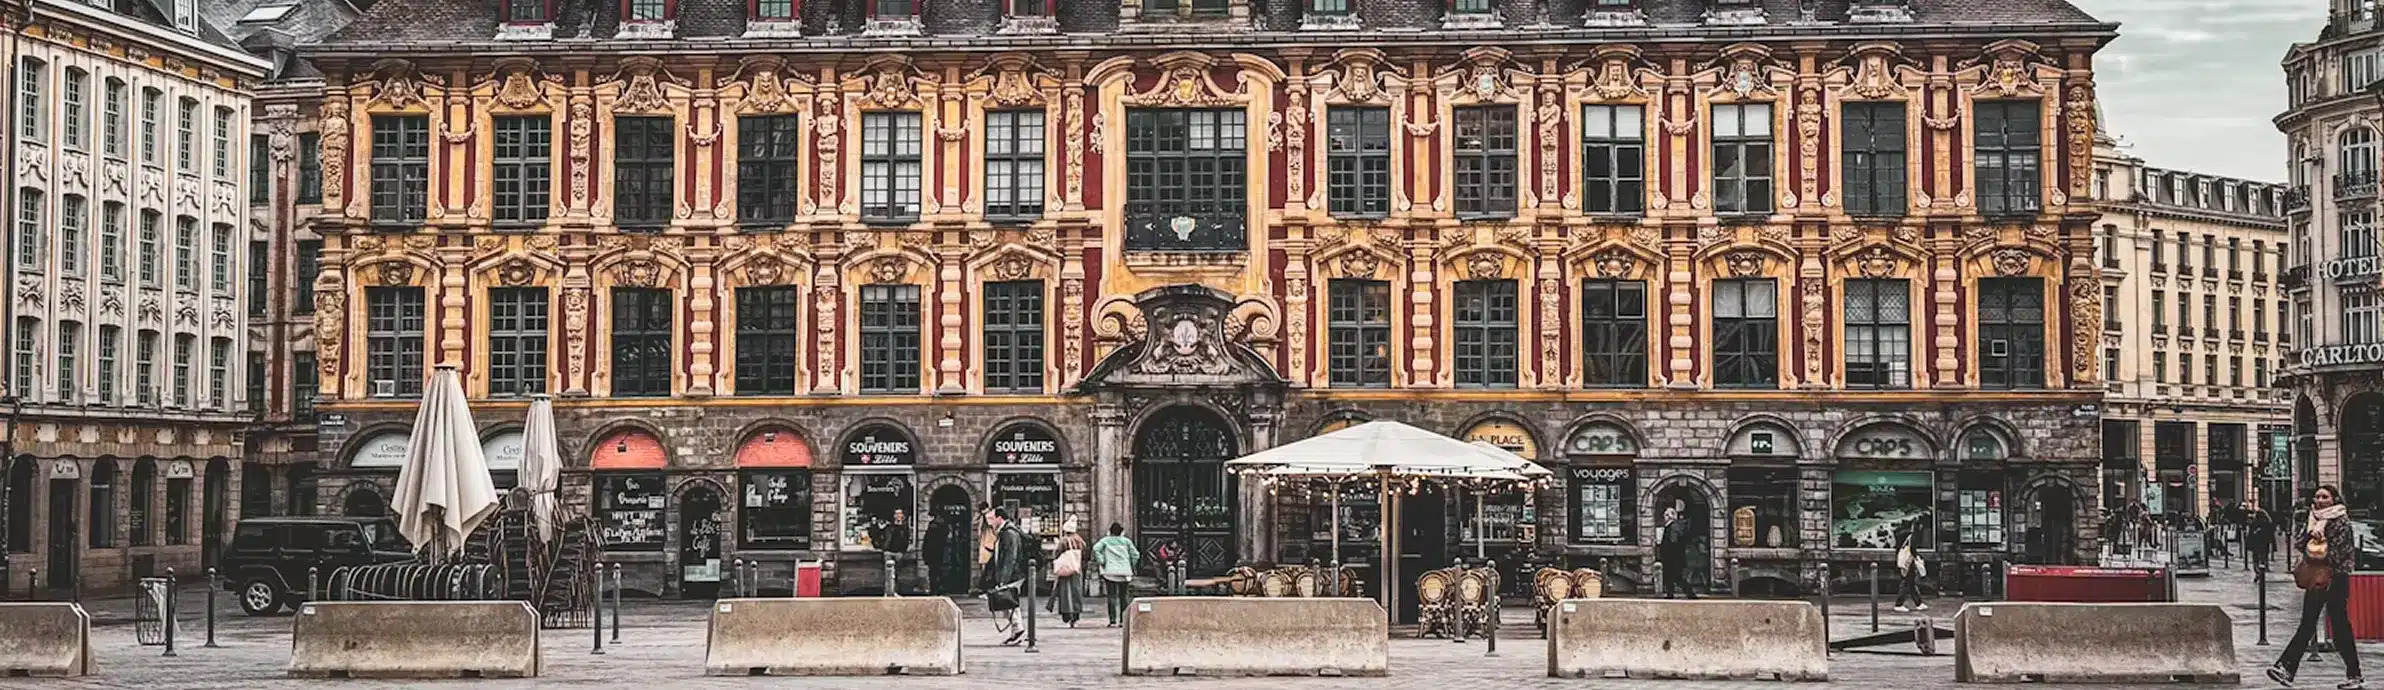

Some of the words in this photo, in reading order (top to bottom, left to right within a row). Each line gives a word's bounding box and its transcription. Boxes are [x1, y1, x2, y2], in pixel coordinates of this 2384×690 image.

[2316, 256, 2382, 279] HOTEL
[1490, 434, 1525, 445] PLACE
[849, 441, 909, 453] SOUVENIRS
[995, 440, 1055, 452] SOUVENIRS
[1573, 468, 1630, 482] voyages
